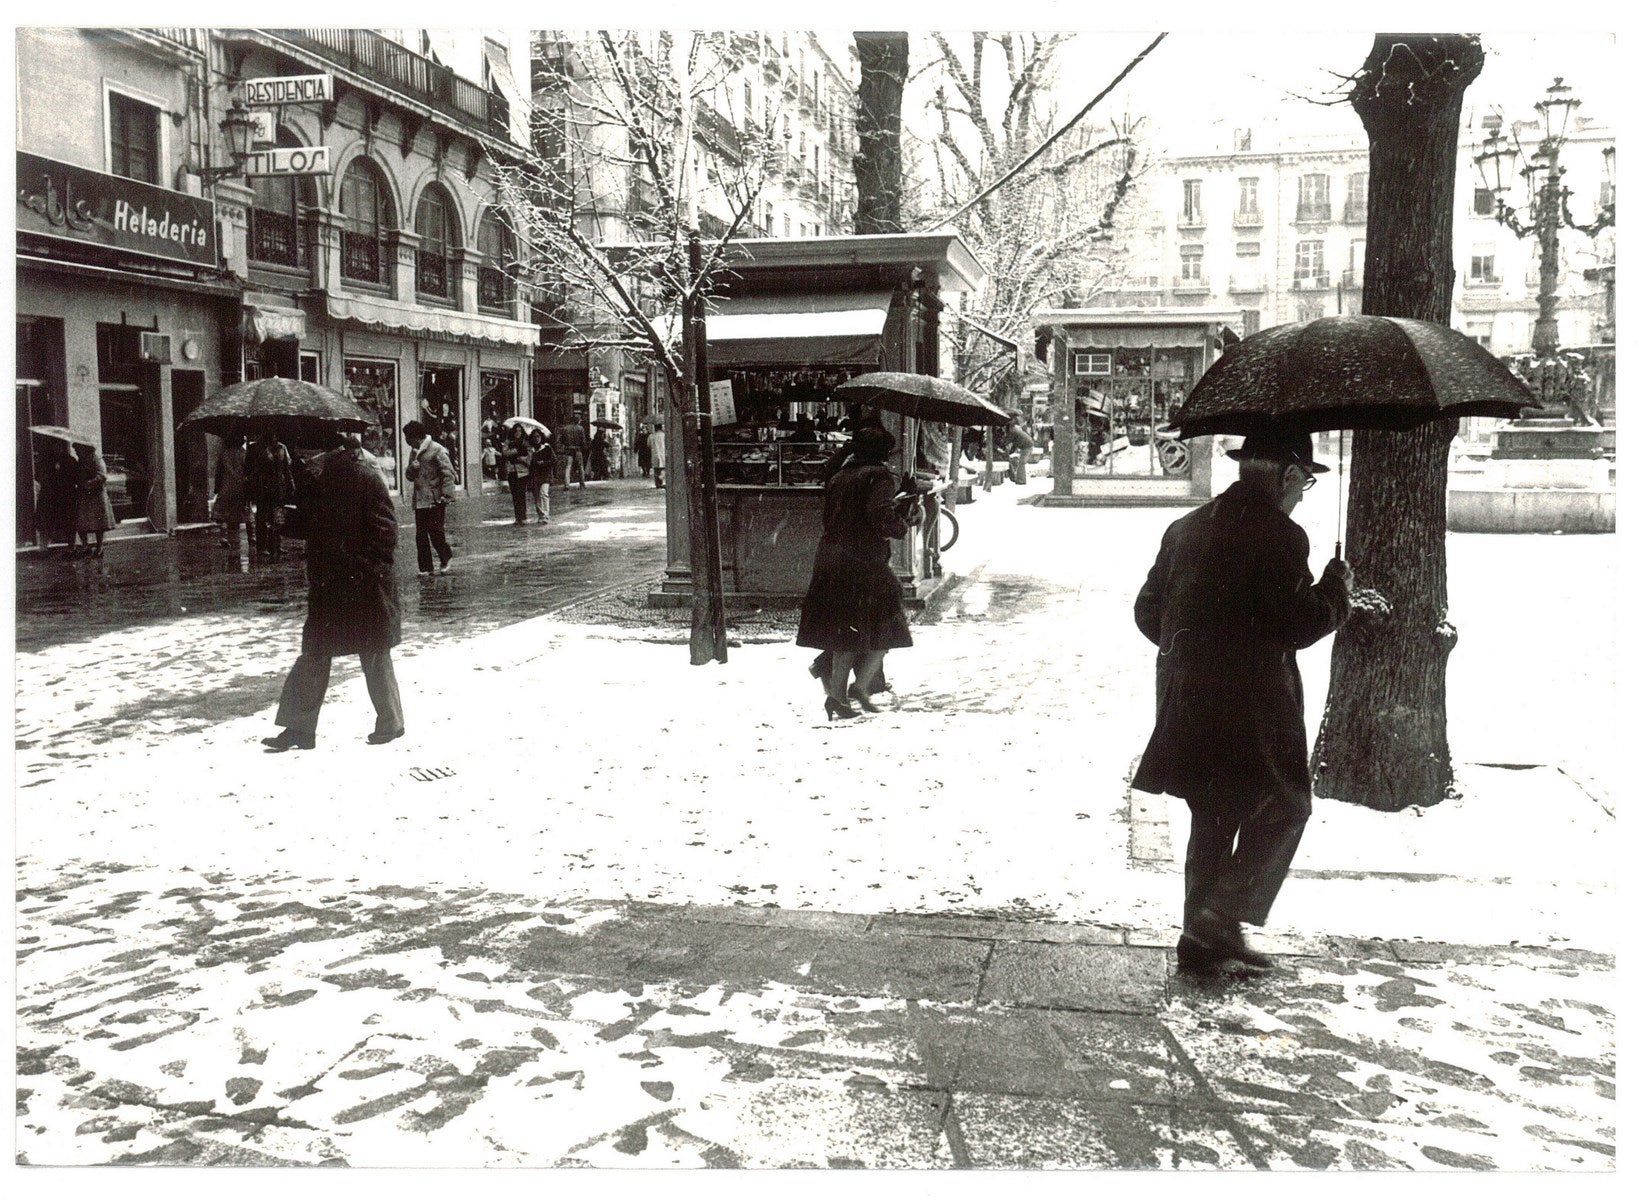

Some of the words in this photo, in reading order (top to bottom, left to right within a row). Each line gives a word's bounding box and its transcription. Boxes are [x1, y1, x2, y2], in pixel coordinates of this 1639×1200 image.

[247, 79, 325, 103] RESIDENCIA
[249, 151, 325, 173] TILOS
[114, 200, 207, 247] Heladeria
